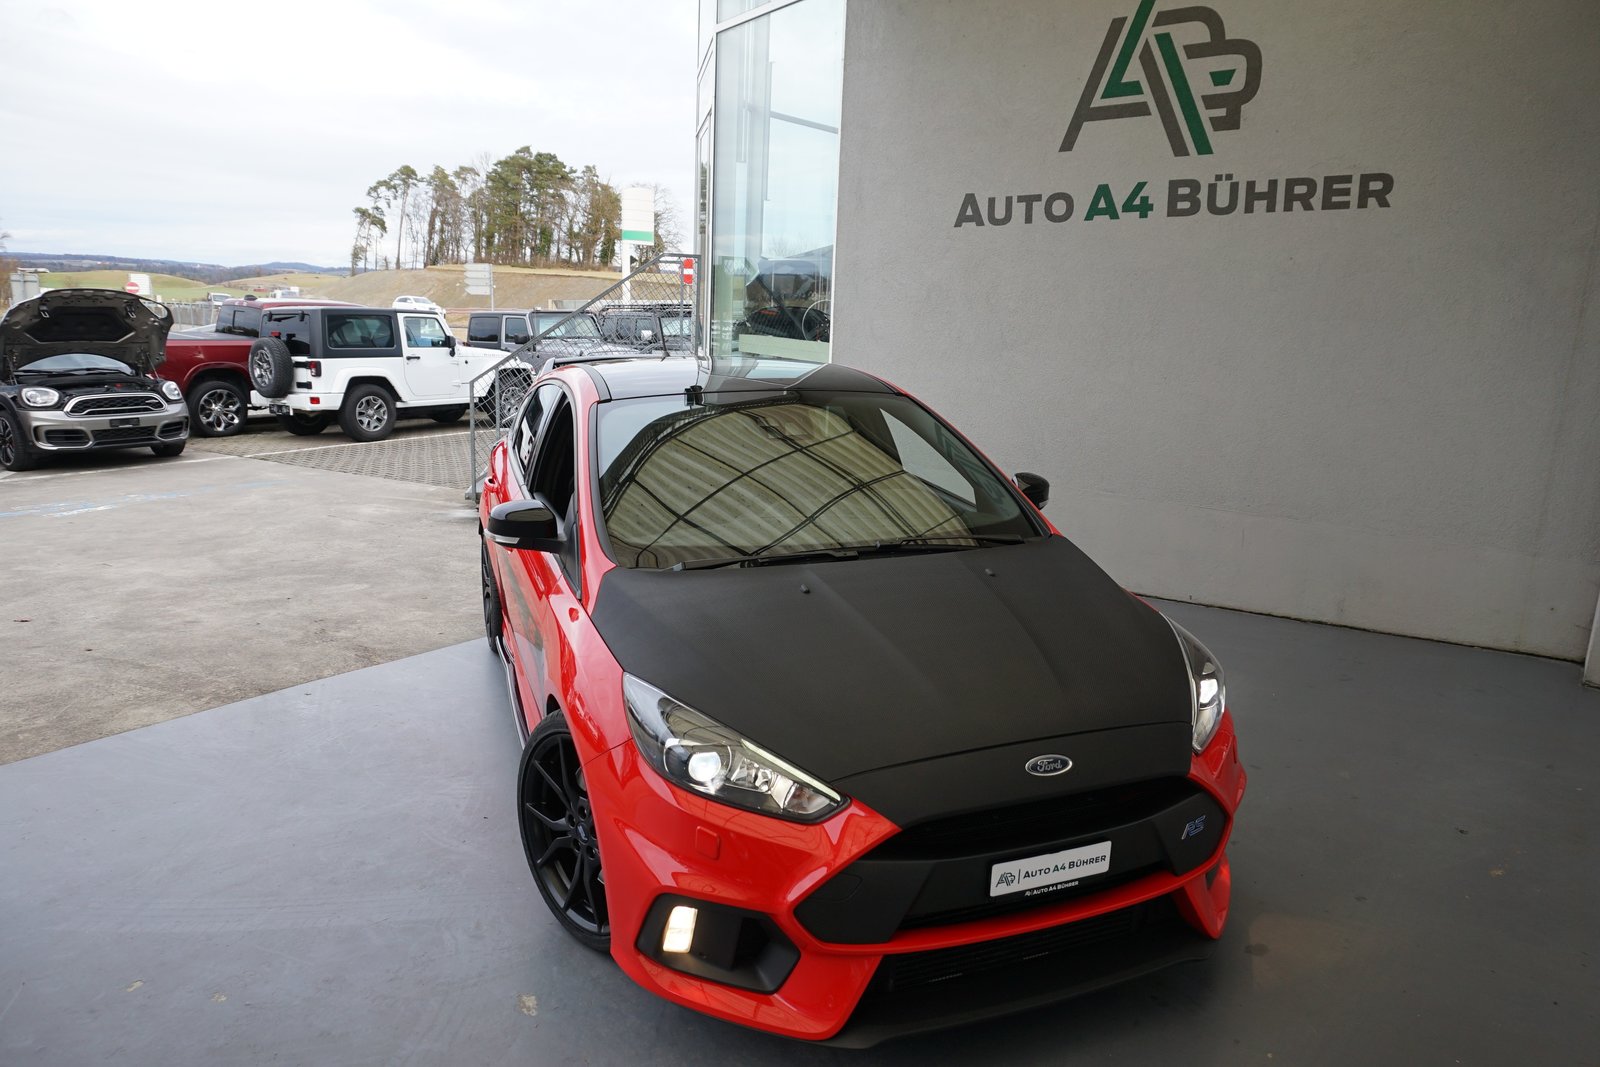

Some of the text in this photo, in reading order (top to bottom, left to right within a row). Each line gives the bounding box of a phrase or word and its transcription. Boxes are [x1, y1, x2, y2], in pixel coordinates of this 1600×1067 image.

[953, 172, 1394, 228] AUTO A4 BÜHRER
[1037, 759, 1062, 771] Ford
[1023, 867, 1050, 880] AUTO
[1052, 863, 1066, 874] A4
[1068, 855, 1107, 870] BÜHRER
[1032, 887, 1048, 896] AUTO
